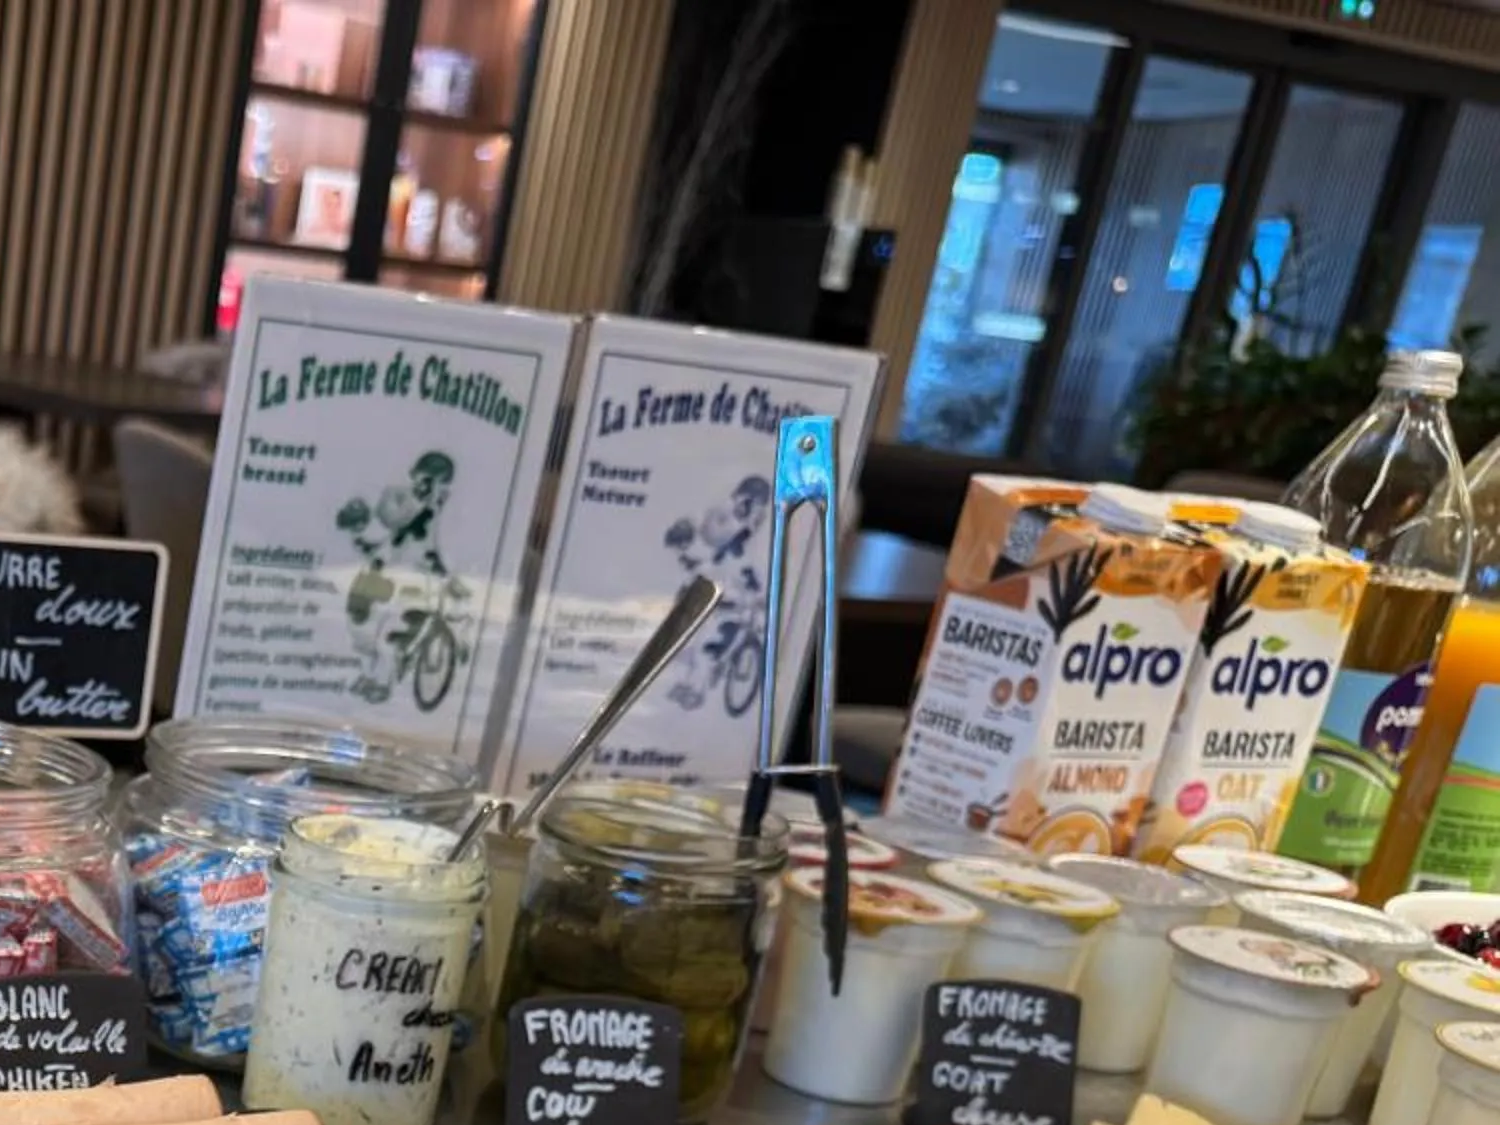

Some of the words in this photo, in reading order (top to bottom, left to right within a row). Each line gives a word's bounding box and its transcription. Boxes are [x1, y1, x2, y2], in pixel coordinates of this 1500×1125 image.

[258, 367, 288, 410] La
[298, 353, 376, 401] Ferme
[384, 351, 411, 395] de
[420, 355, 524, 437] Chatillon
[598, 398, 625, 437] La
[633, 385, 705, 429] Ferme
[710, 383, 736, 424] de
[248, 435, 318, 461] Yaourt
[35, 583, 141, 630] doux
[942, 615, 1044, 668] BARISTAS
[1061, 623, 1182, 700] alpro
[1211, 636, 1329, 710] alpro
[16, 677, 131, 721] butter
[1053, 720, 1146, 751] BARISTA
[1201, 730, 1296, 760] BARISTA
[1047, 763, 1129, 793] ALMOND
[1217, 773, 1265, 801] OAT
[938, 986, 1048, 1026] FROMAGE
[28, 1019, 128, 1054] volaille
[524, 1008, 654, 1050] FROMAGE
[348, 1040, 435, 1086] Aneth
[932, 1061, 1011, 1094] GOAT
[526, 1086, 596, 1122] COW
